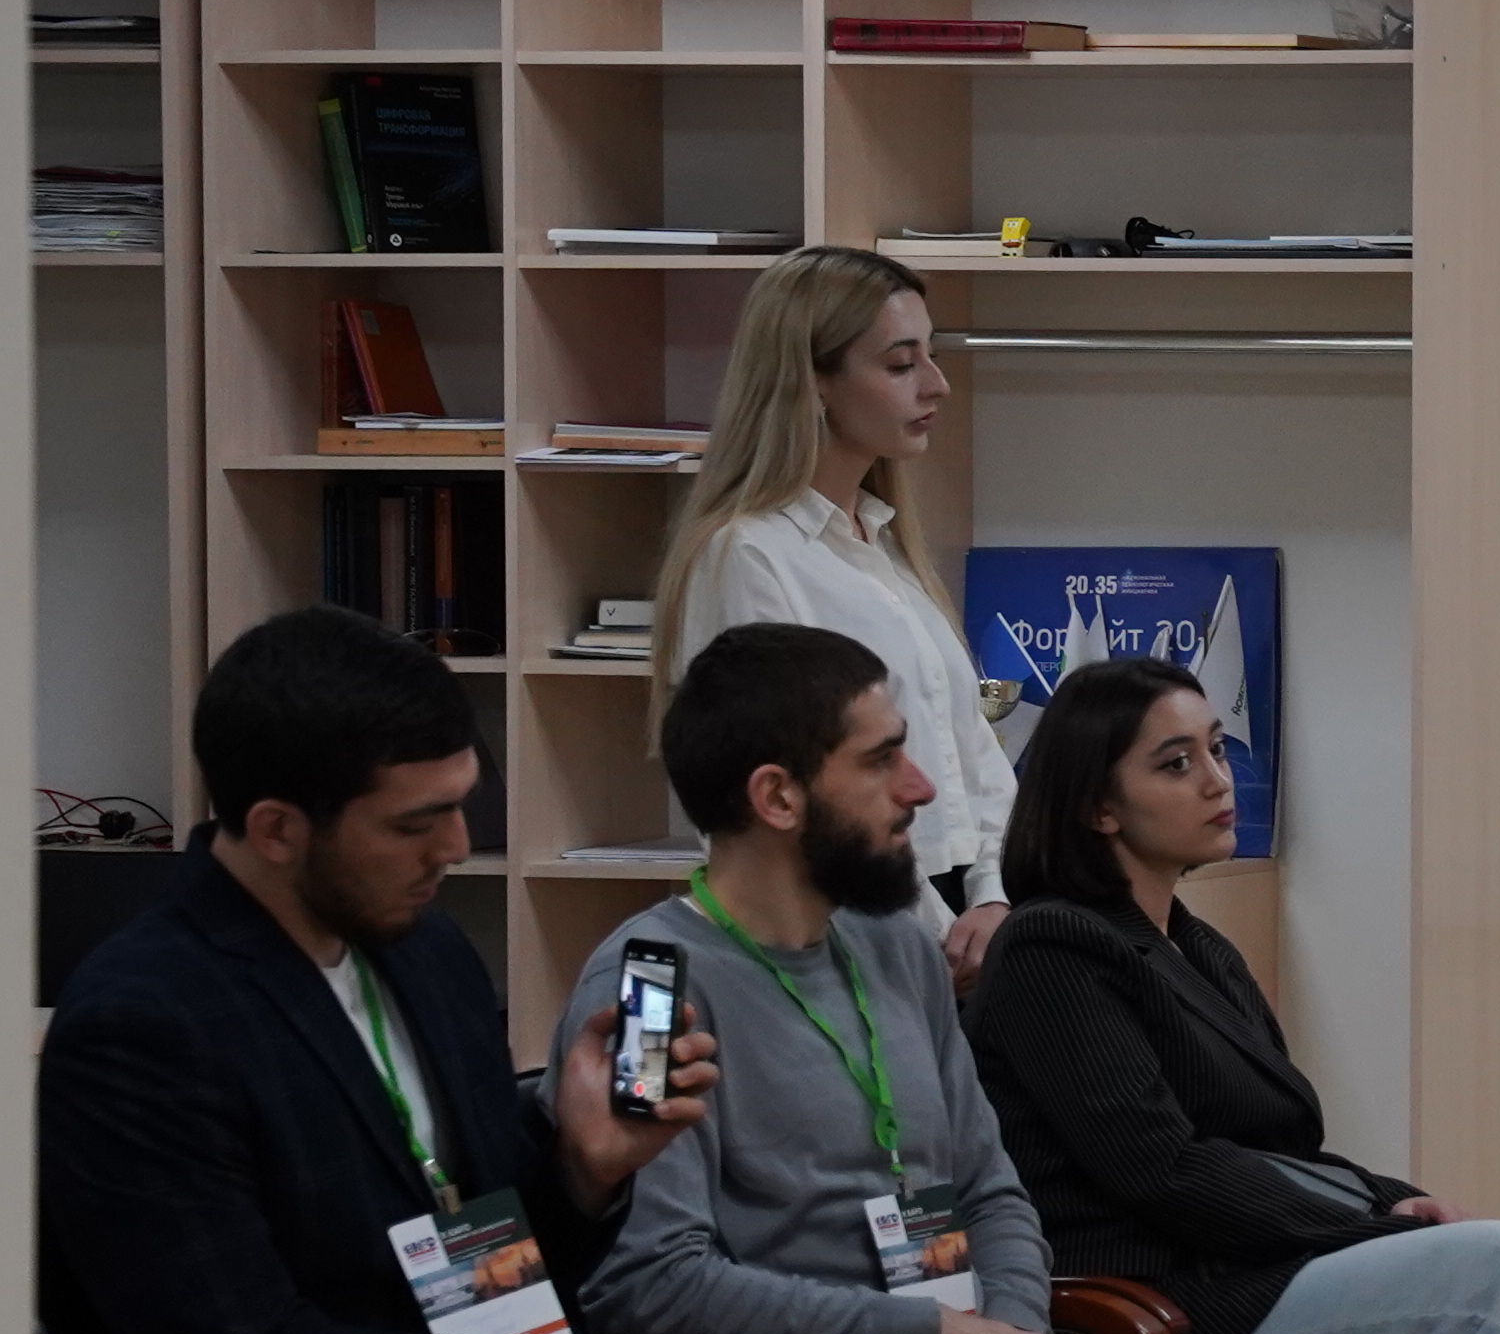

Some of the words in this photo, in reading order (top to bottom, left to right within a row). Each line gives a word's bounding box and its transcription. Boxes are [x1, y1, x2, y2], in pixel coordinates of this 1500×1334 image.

[375, 107, 431, 120] ЦИФРОВАЯ
[378, 122, 466, 137] ТРАНСФОРМАЦИЯ
[1065, 575, 1118, 595] 20.35
[1010, 618, 1144, 657] Форйт
